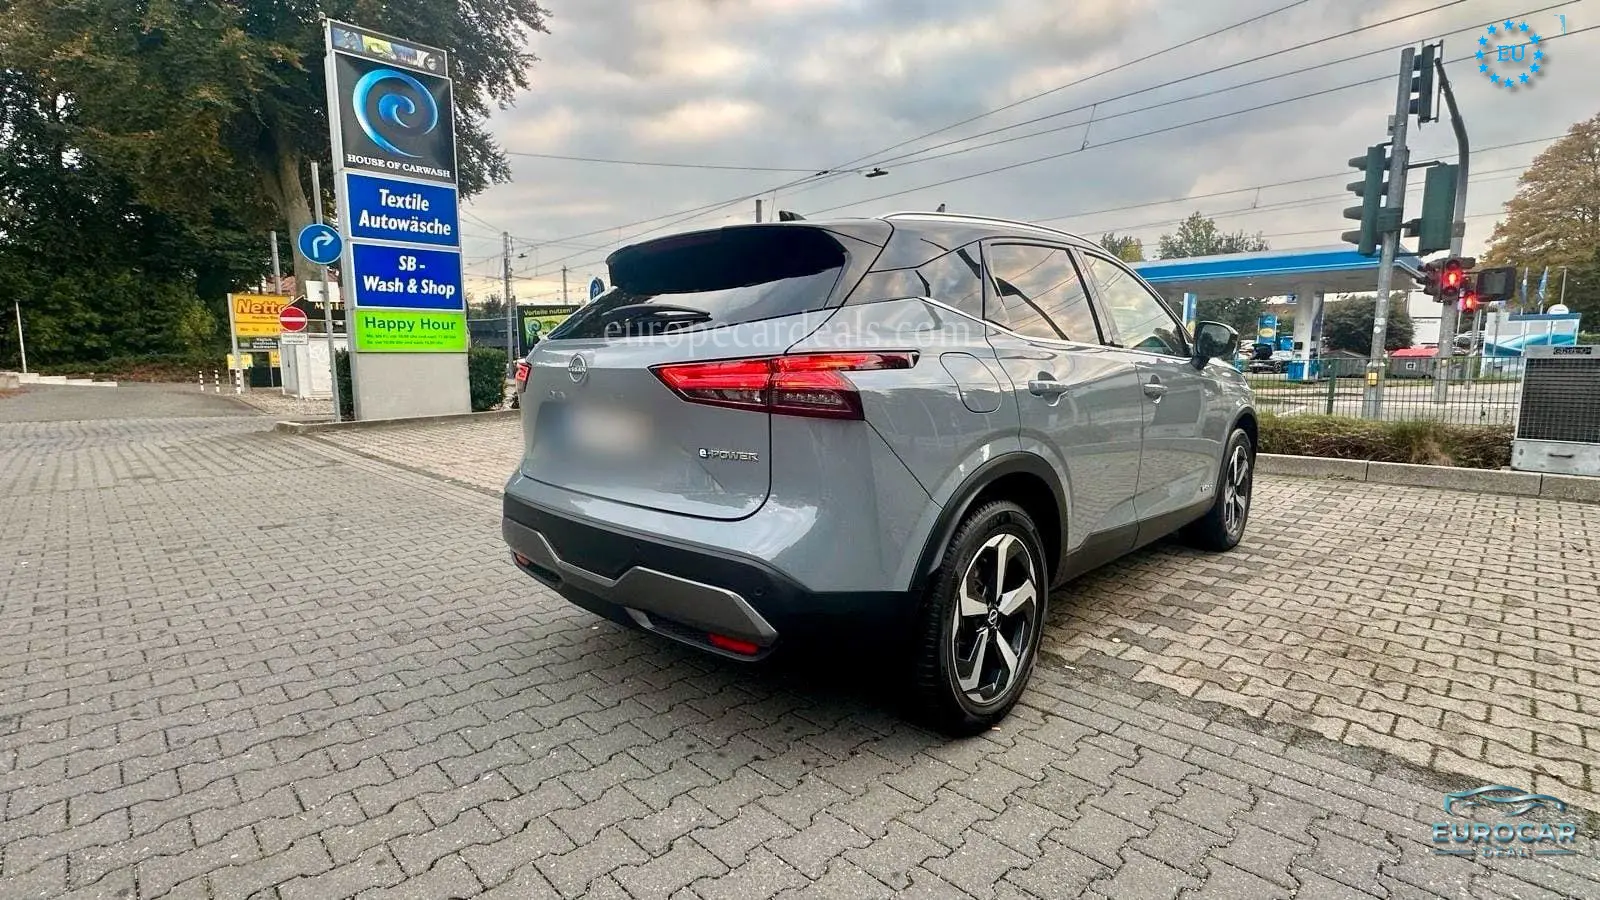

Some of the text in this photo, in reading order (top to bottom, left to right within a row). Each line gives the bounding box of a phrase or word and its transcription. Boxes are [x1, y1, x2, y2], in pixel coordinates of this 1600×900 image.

[347, 154, 451, 178] HOUSE OF CARWASH
[379, 188, 430, 211] Textile
[358, 209, 452, 236] Autowäsche
[398, 255, 417, 272] SB
[363, 275, 456, 300] Wash & Shop
[364, 316, 457, 333] Happy Hour
[699, 448, 759, 463] e-POWER
